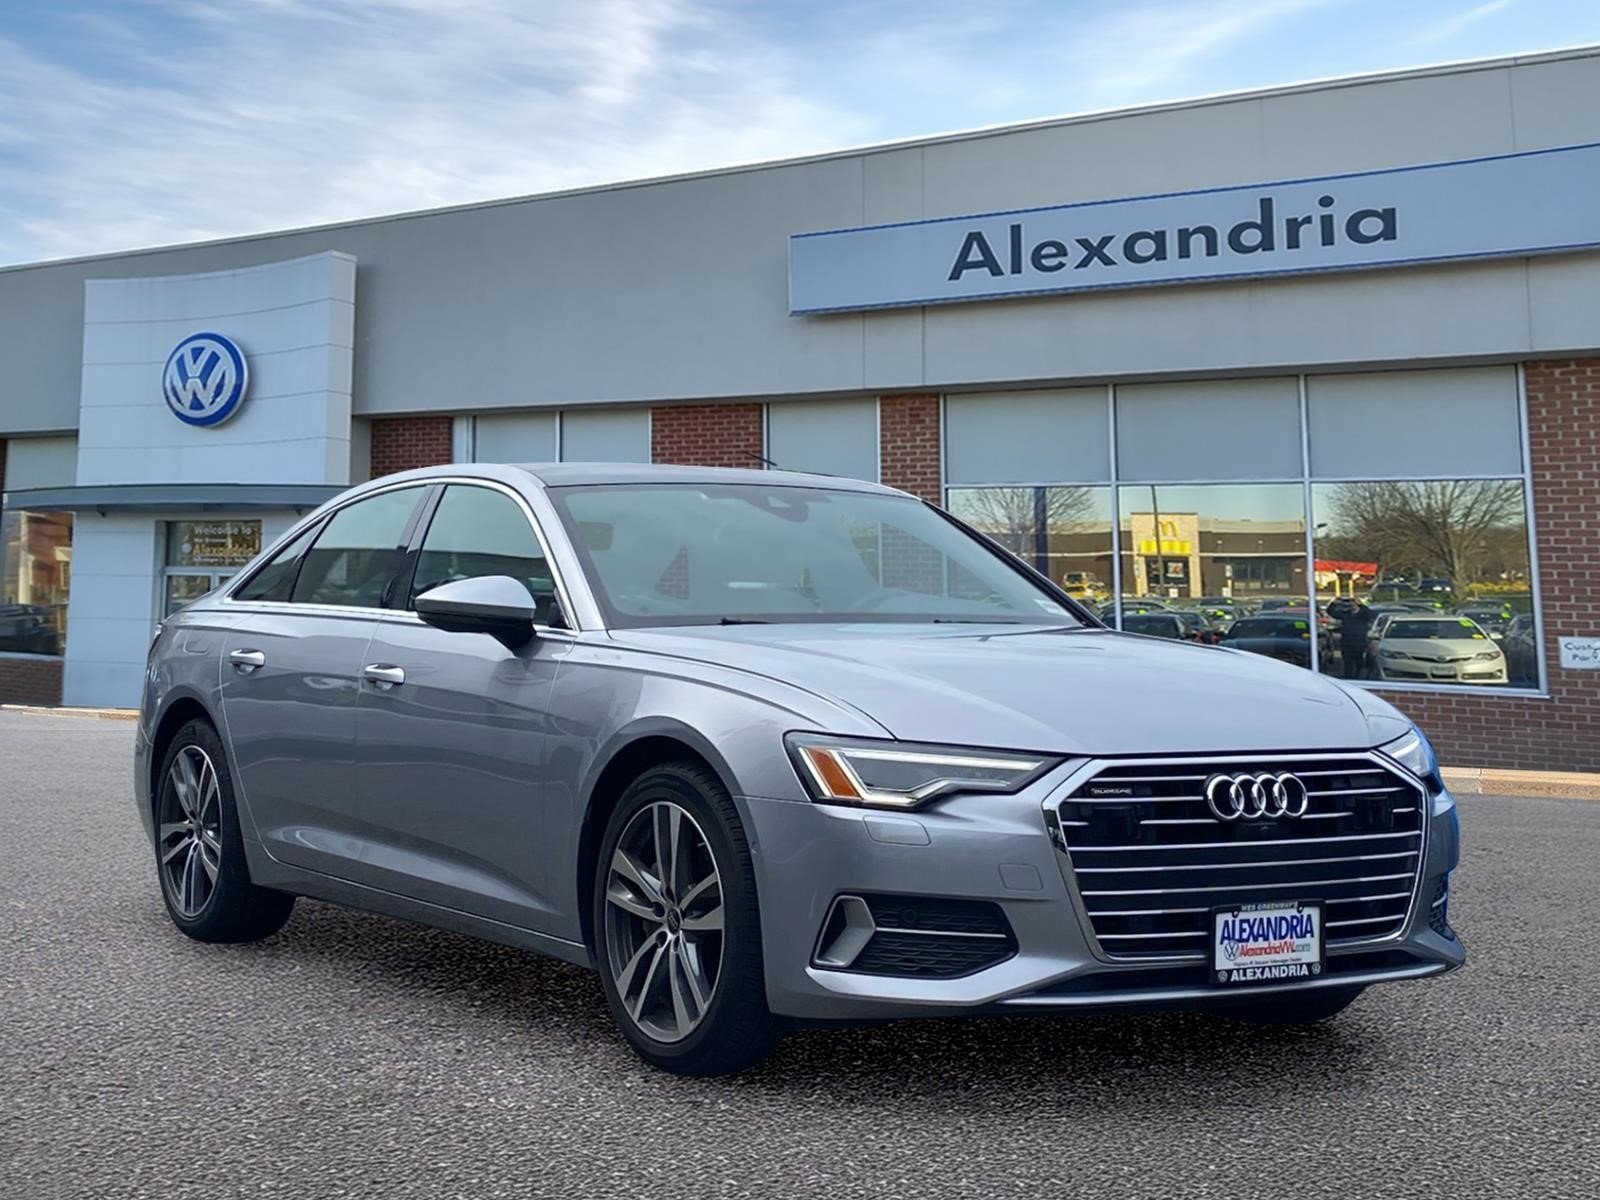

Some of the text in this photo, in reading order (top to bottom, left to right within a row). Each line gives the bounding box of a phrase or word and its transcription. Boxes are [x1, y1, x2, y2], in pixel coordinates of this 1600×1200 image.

[947, 194, 1397, 281] Alexandria
[165, 338, 237, 419] VW
[1220, 914, 1315, 945] ALEXANDRIA
[1239, 940, 1311, 957] AlexandriaVW.com
[1231, 963, 1309, 982] ALEXANDRIA
